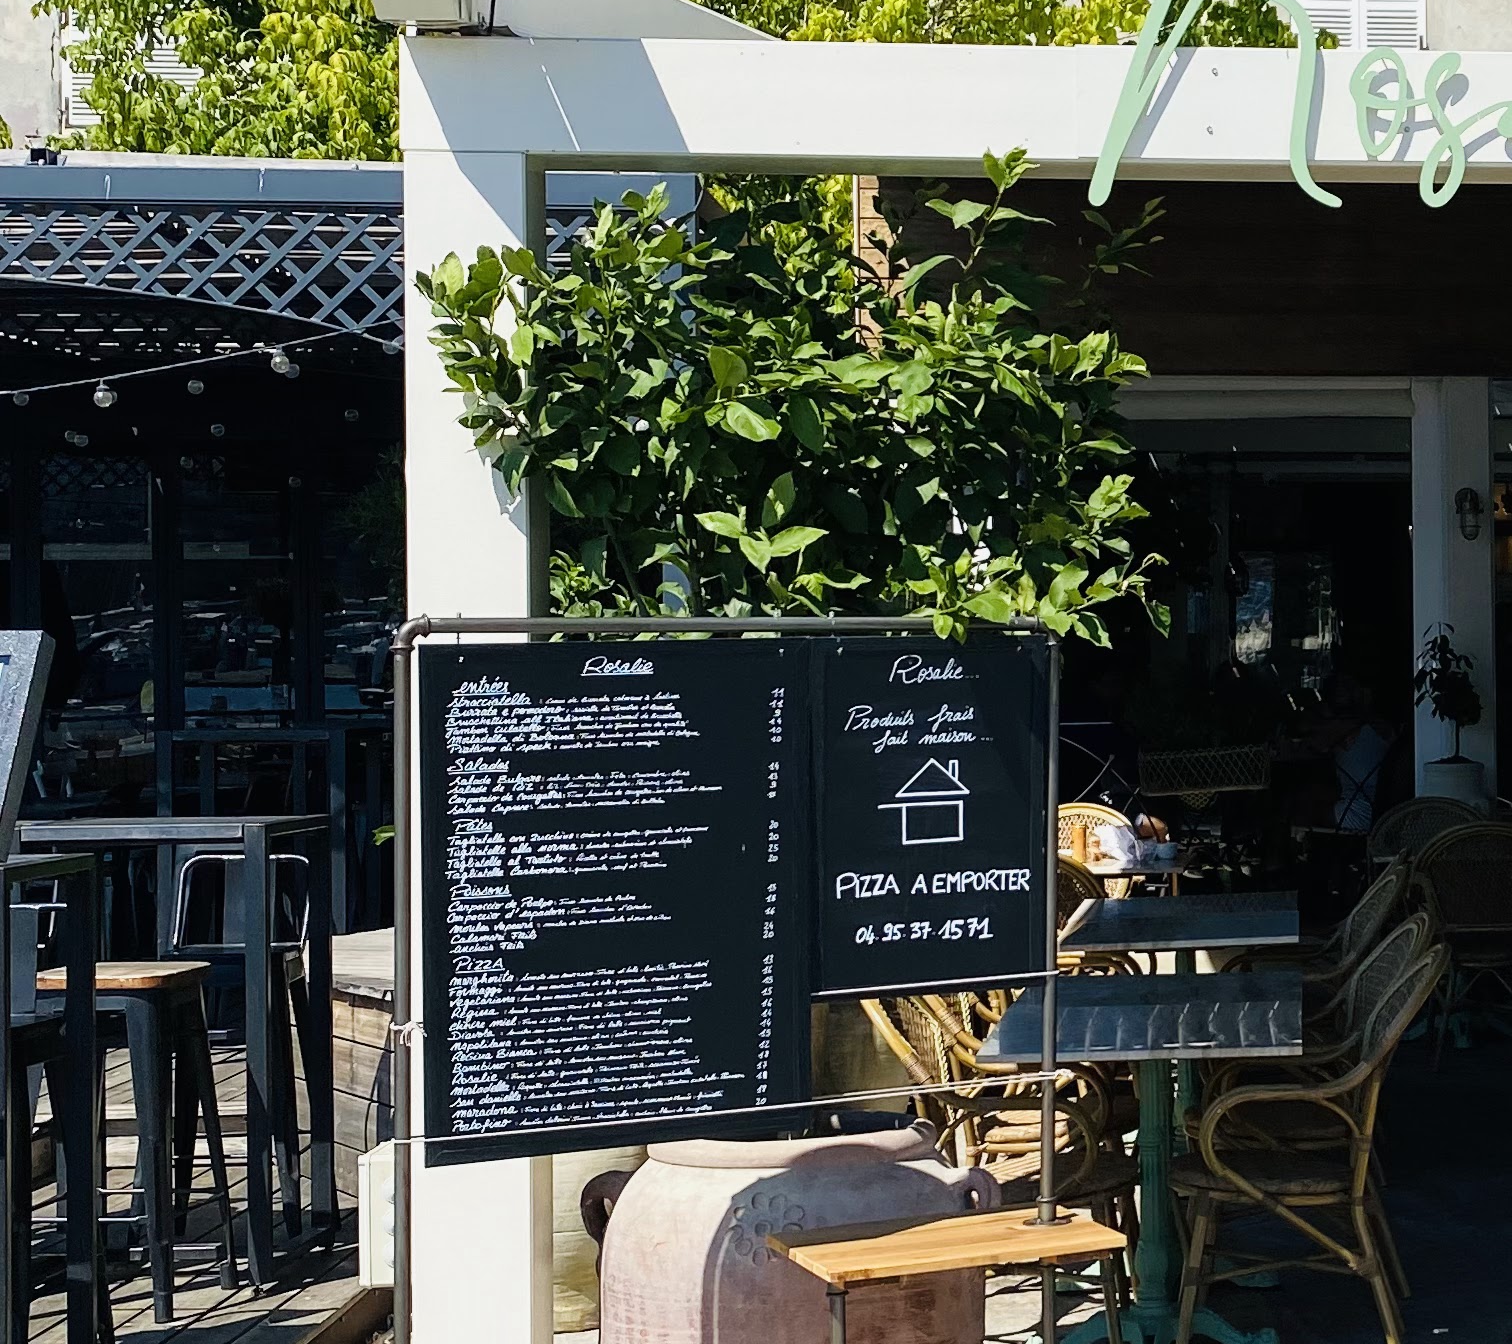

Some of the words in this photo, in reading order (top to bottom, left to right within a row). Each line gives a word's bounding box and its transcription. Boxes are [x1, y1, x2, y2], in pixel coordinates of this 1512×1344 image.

[581, 656, 653, 675] Rosalie
[844, 705, 914, 731] Produits
[927, 704, 974, 732] frais
[873, 731, 909, 753] fait
[836, 871, 900, 899] PIZZA
[932, 868, 1031, 894] EMPORTER
